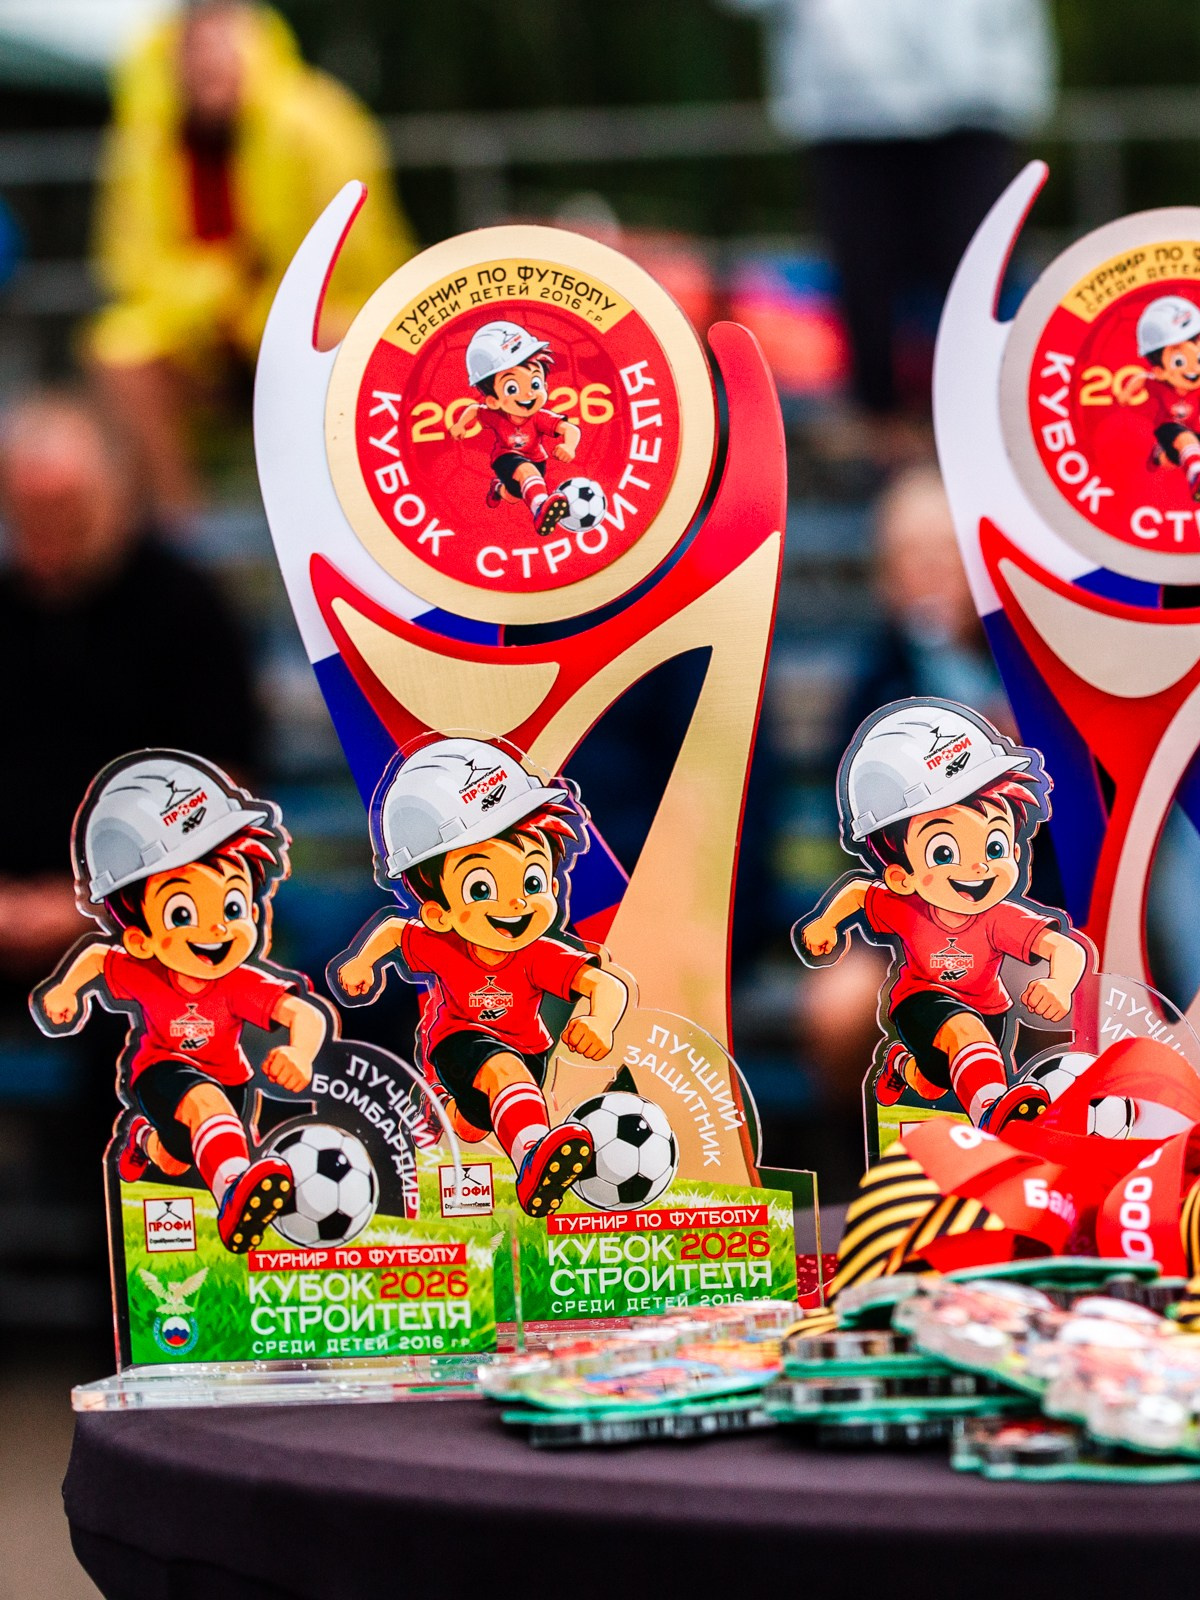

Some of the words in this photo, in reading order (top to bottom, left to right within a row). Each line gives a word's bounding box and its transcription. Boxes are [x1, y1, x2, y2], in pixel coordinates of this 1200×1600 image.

[1155, 247, 1183, 262] ПО
[396, 277, 468, 335] ТУРНИР
[477, 267, 507, 288] ПО
[517, 265, 617, 311] ФУТБОЛУ
[410, 301, 461, 346] СРЕДИ
[470, 282, 529, 305] ДЕТЕЙ
[540, 287, 582, 310] 2016
[1039, 350, 1114, 514] КУБОК
[369, 390, 456, 557] КУБОК
[476, 360, 663, 578] СТРОИТЕЛЯ
[647, 1024, 746, 1132] ЛУЧШИЙ
[346, 1055, 445, 1167] ЛУЧШИЙ
[623, 1045, 721, 1167] ЗАЩИТНИК
[312, 1073, 420, 1211] БОМБАРДИР
[149, 1220, 191, 1232] ПРОФИ
[554, 1214, 628, 1232] ТУРНИР
[635, 1212, 661, 1229] ПО
[669, 1209, 760, 1228] ФУТБОЛУ
[256, 1251, 328, 1268] ТУРНИР
[335, 1250, 361, 1266] ПО
[368, 1247, 459, 1266] ФУТБОЛУ
[548, 1235, 675, 1266] КУБОК
[680, 1230, 770, 1260] 2026
[249, 1271, 373, 1304] КУБОК
[379, 1270, 469, 1299] 2026
[549, 1261, 773, 1297] СТРОИТЕЛЯ
[250, 1301, 471, 1336] СТРОИТЕЛЯ
[551, 1297, 616, 1314] СРЕДИ
[627, 1294, 689, 1312] ДЕТЕЙ
[252, 1339, 316, 1354] СРЕДИ
[326, 1336, 389, 1353] ДЕТЕЙ
[399, 1335, 444, 1350] 2016
